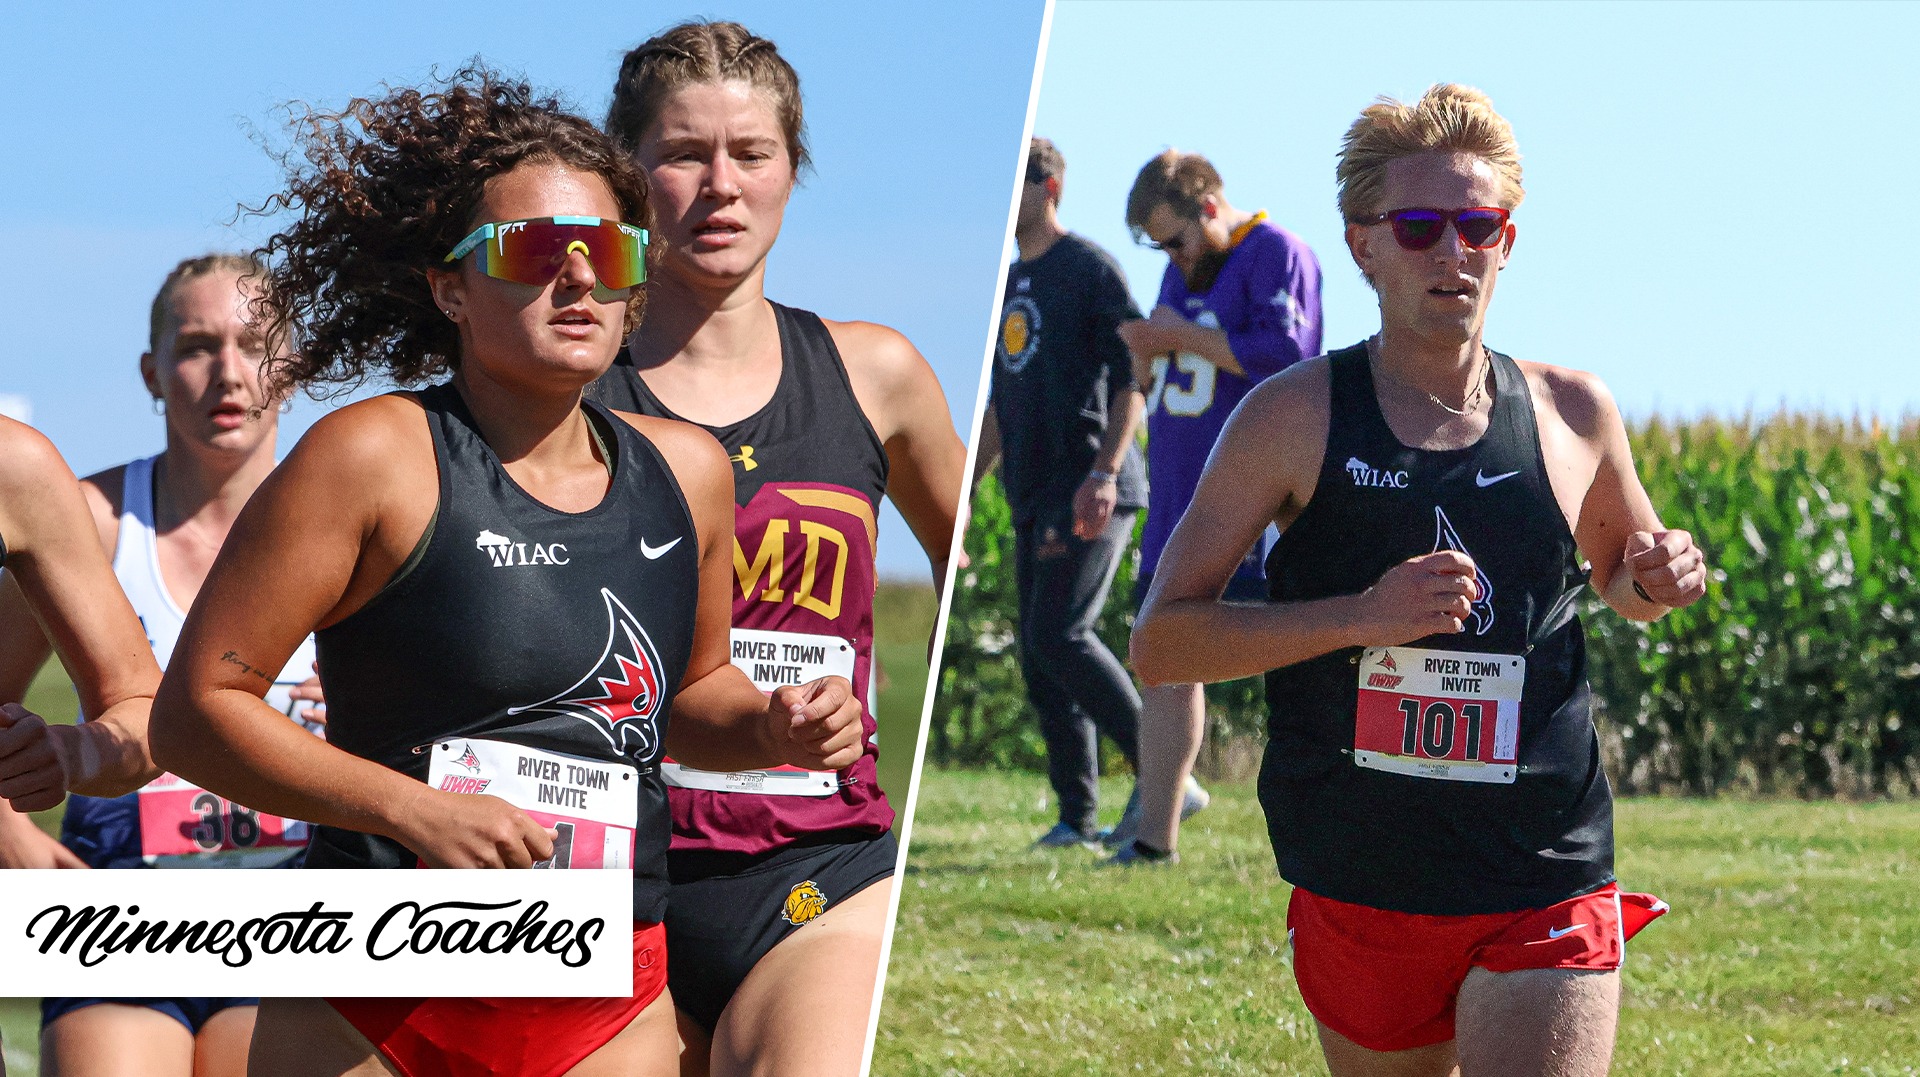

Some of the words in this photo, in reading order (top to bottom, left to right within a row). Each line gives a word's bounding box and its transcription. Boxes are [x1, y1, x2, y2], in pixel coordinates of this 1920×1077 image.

[1347, 464, 1409, 489] WIAC
[477, 537, 570, 567] WIAC
[732, 640, 776, 662] RIVER
[782, 643, 826, 665] TOWN
[753, 663, 803, 685] INVITE
[1424, 658, 1463, 675] RIVER
[1464, 660, 1501, 677] TOWN
[1441, 677, 1482, 694] INVITE
[1398, 698, 1483, 761] 101
[438, 774, 491, 795] UWRF
[517, 756, 561, 782] RIVER
[566, 764, 610, 791] TOWN
[537, 783, 588, 810] INVITE
[190, 792, 261, 851] 38
